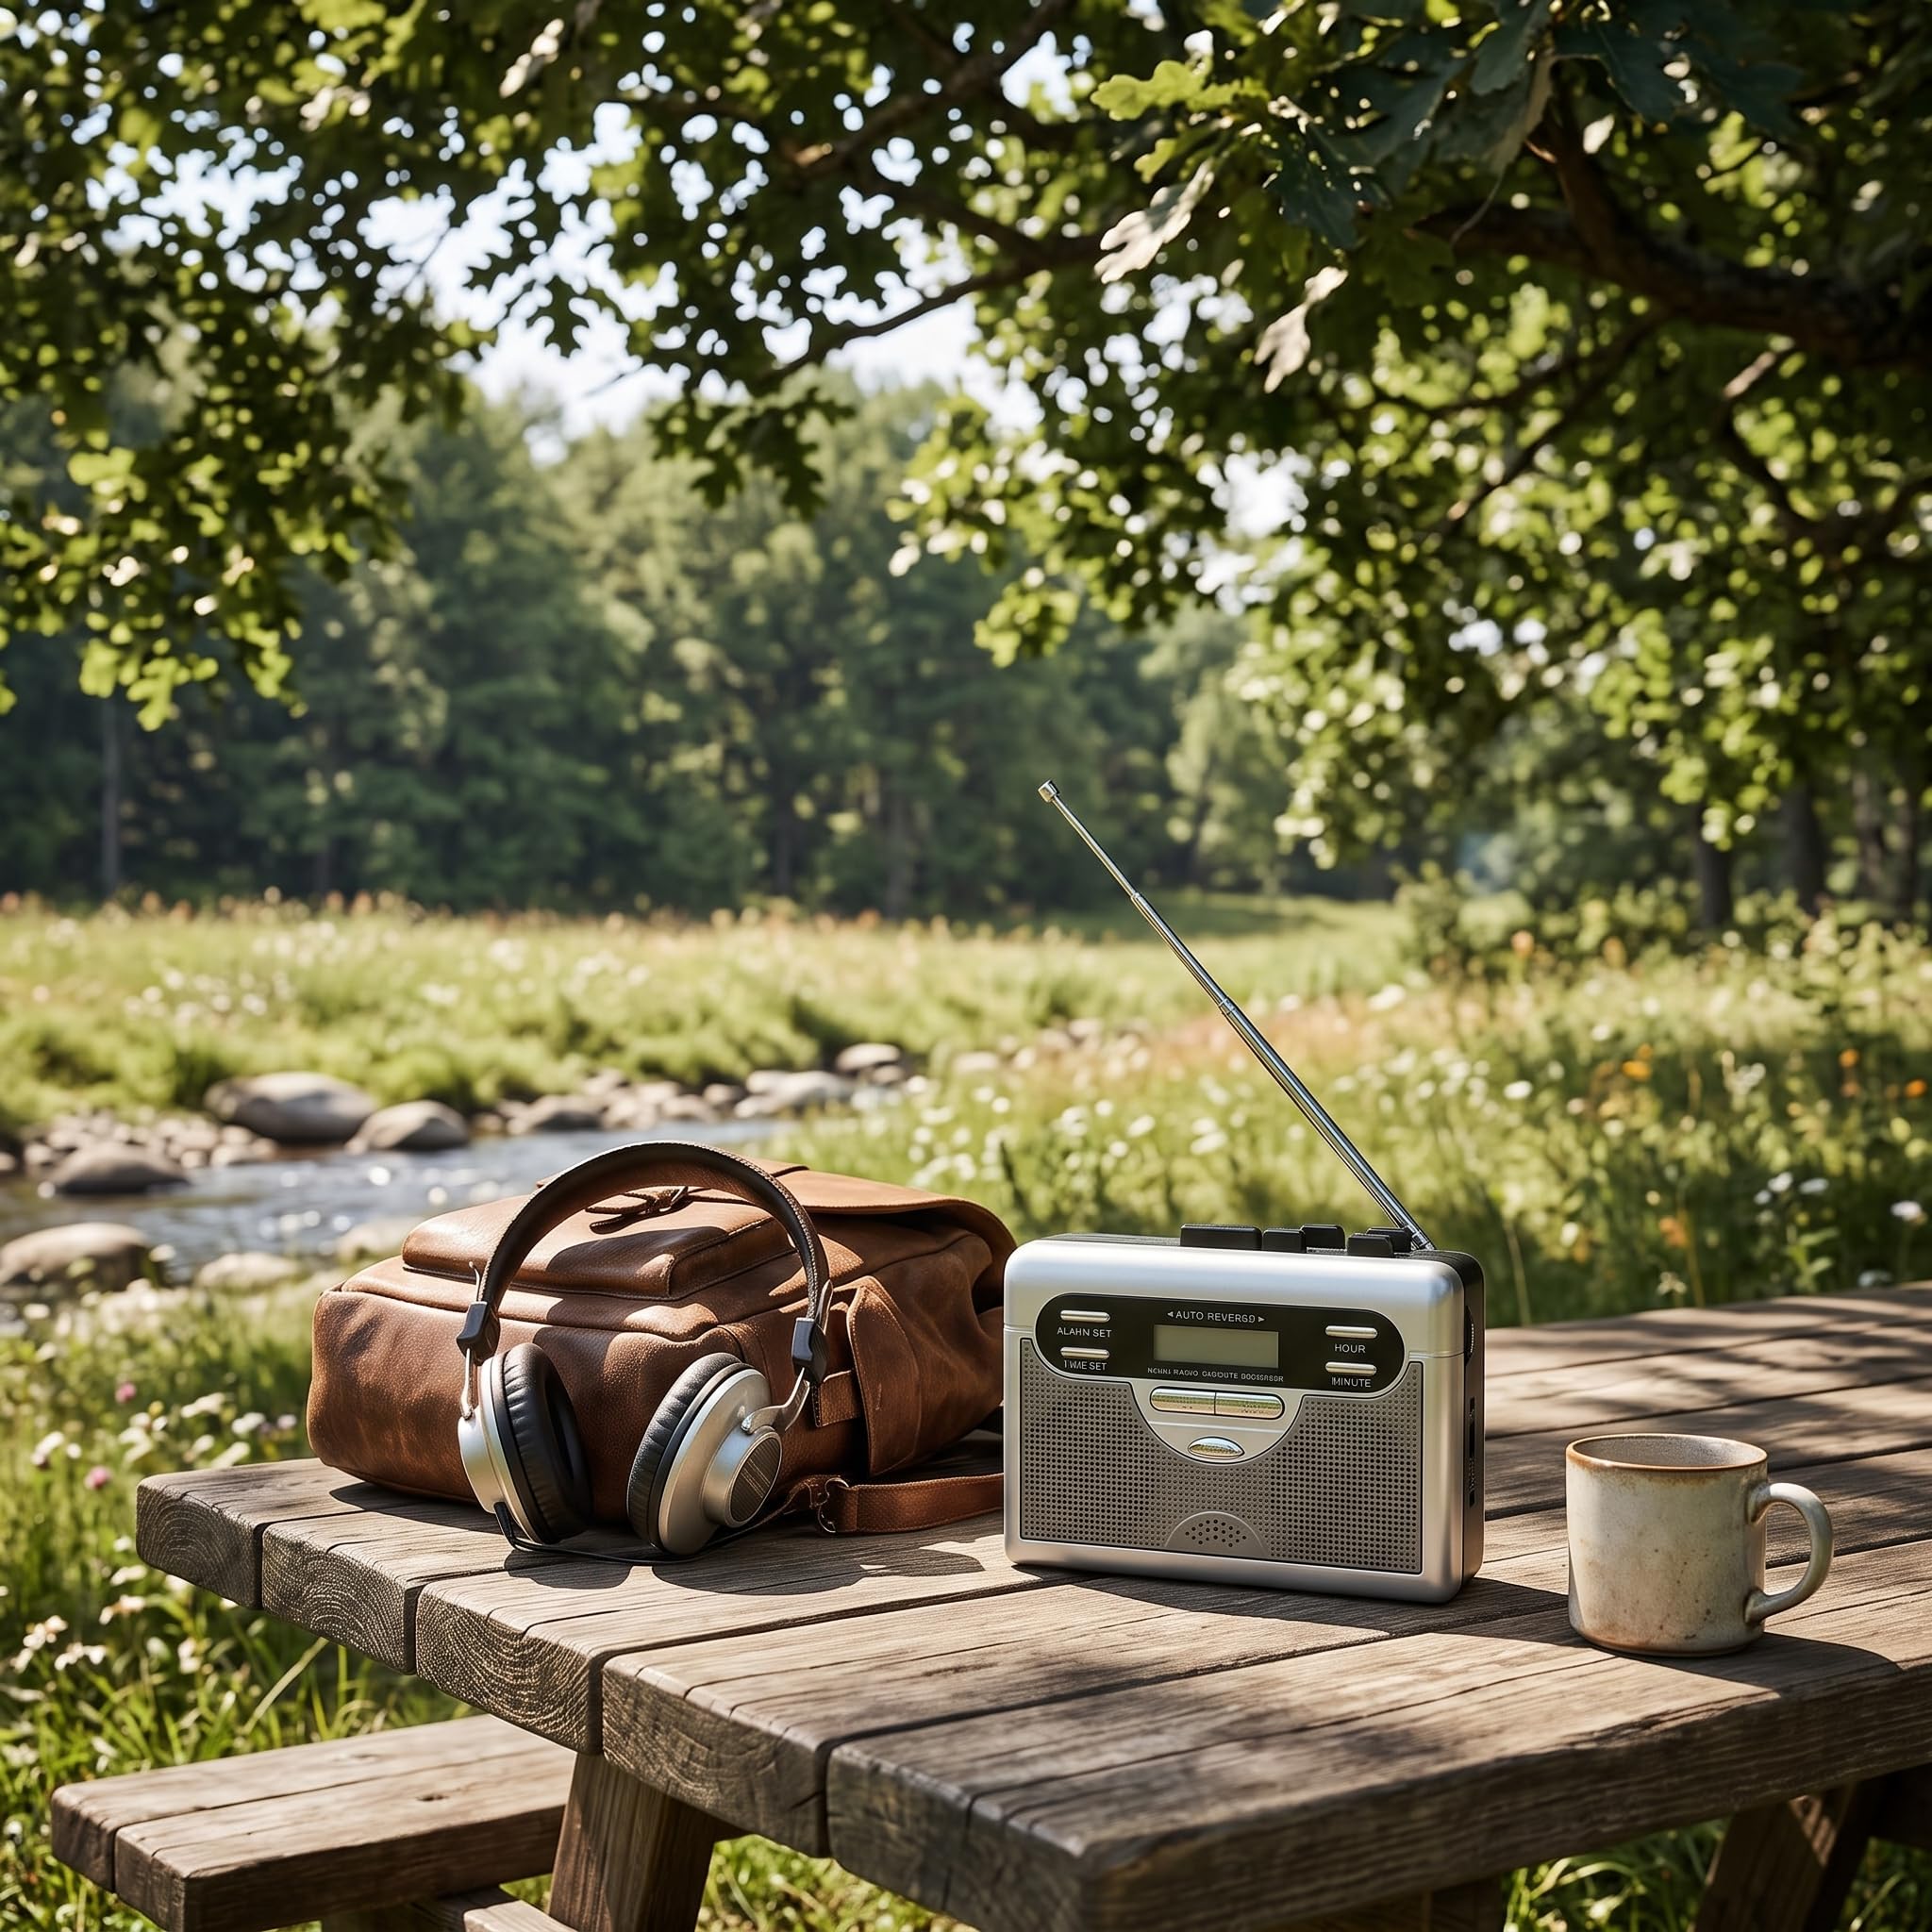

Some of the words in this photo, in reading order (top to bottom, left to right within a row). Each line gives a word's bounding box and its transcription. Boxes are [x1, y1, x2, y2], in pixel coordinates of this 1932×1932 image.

[1175, 1310, 1205, 1321] AUTO
[1092, 1329, 1112, 1338] SET
[1334, 1343, 1366, 1354] HOUR
[1089, 1362, 1108, 1371] SET
